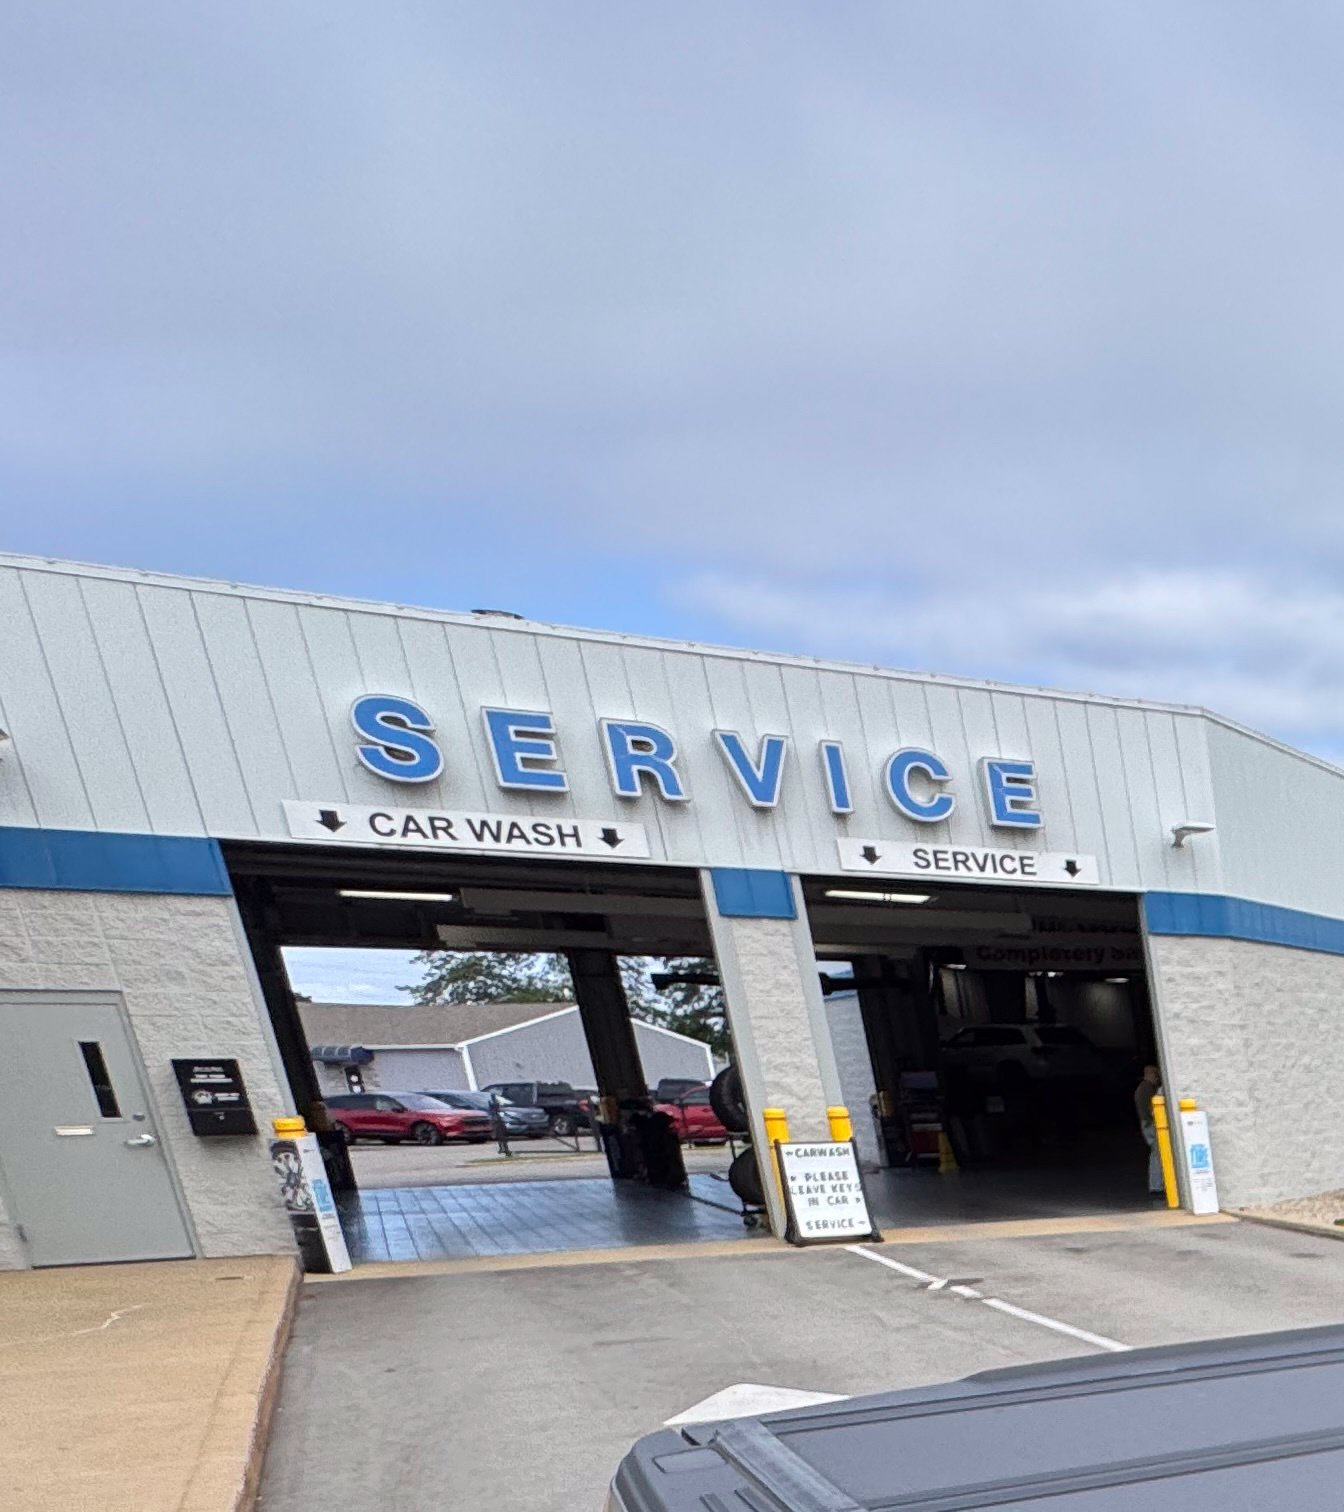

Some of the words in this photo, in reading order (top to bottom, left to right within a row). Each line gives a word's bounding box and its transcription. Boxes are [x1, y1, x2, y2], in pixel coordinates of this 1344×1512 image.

[350, 694, 1045, 829] SERVICE
[368, 811, 458, 842] CAR
[465, 817, 582, 850] WASH
[913, 847, 1038, 876] SERVICE
[804, 1171, 849, 1182] PLEASE
[791, 1184, 826, 1195] LEAVE
[831, 1183, 862, 1193] KEYS
[827, 1195, 849, 1206] CAR
[806, 1218, 855, 1230] SERVICE
